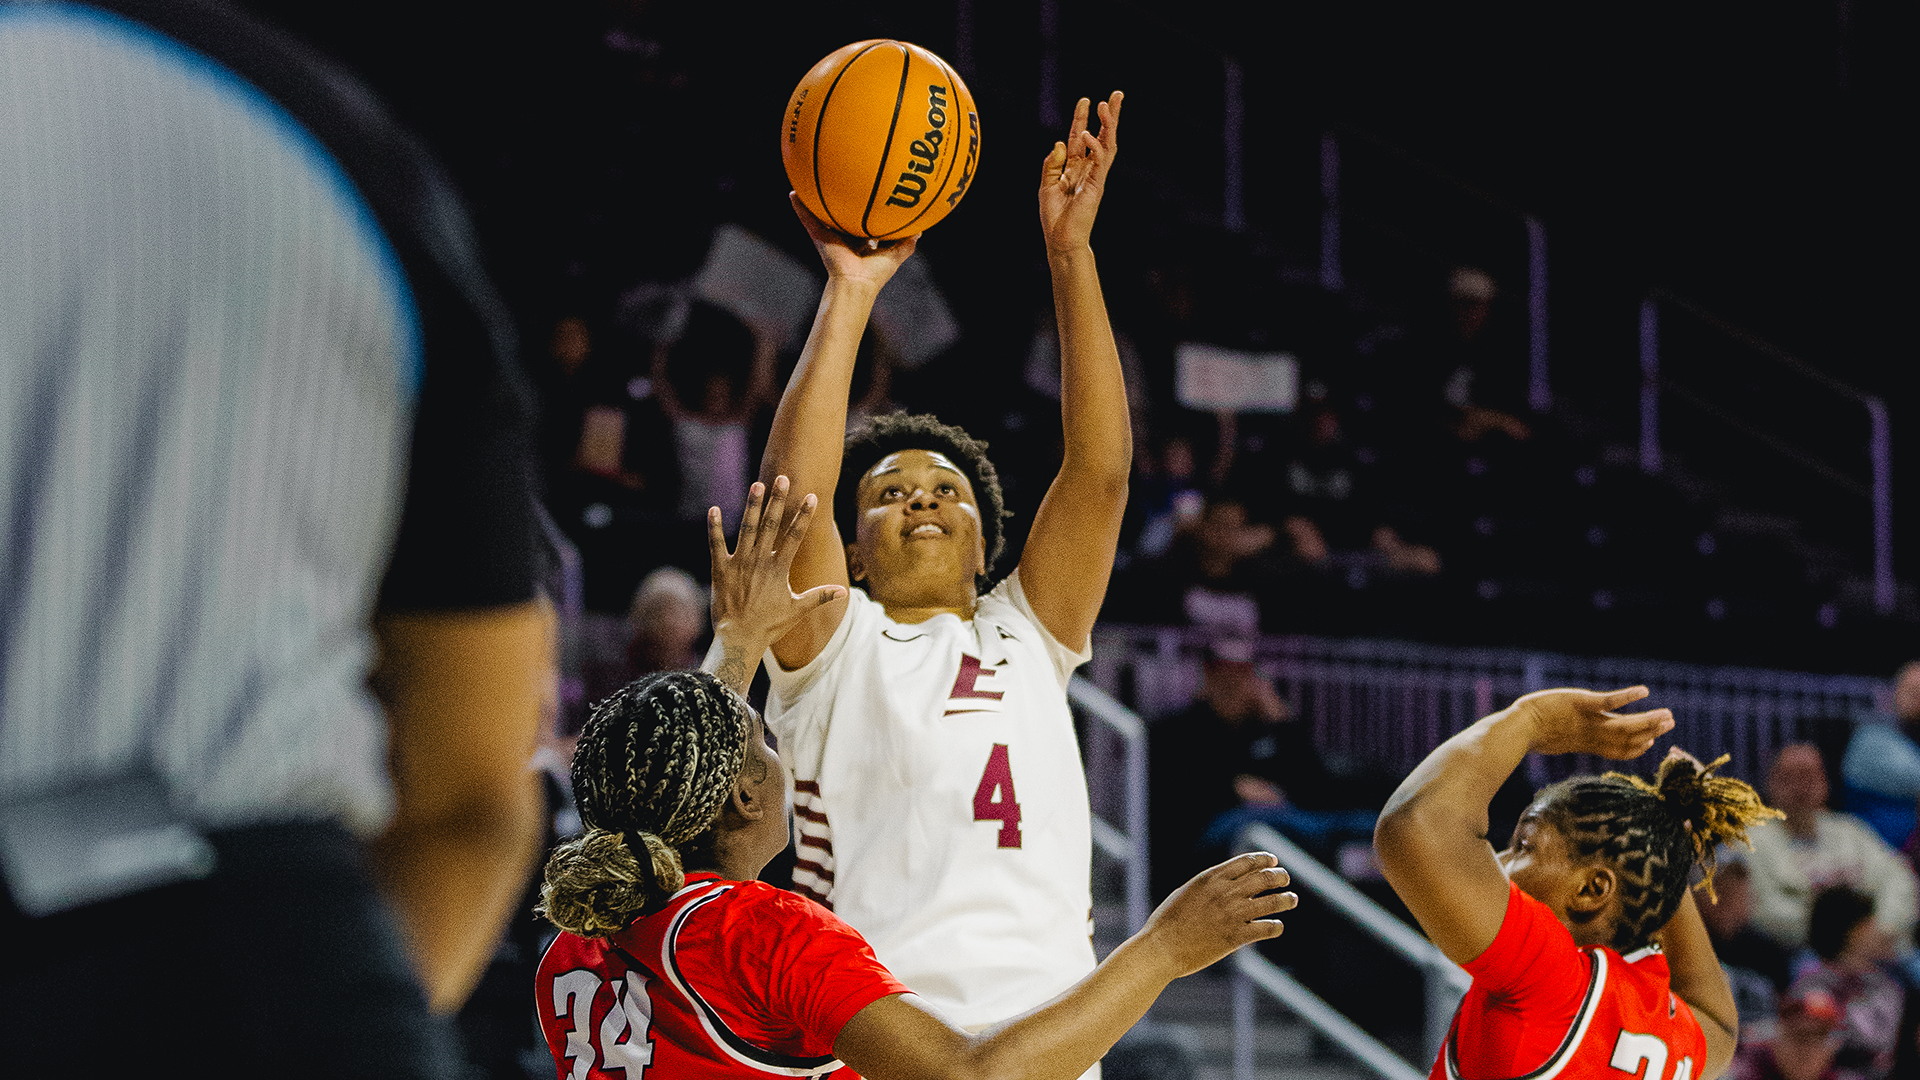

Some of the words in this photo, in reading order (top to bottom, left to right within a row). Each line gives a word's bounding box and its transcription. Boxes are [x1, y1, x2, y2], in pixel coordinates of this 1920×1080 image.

[885, 84, 948, 209] Wilson
[946, 111, 979, 210] NCAA
[948, 652, 1005, 701] E
[972, 742, 1023, 850] 4
[552, 969, 654, 1080] 34
